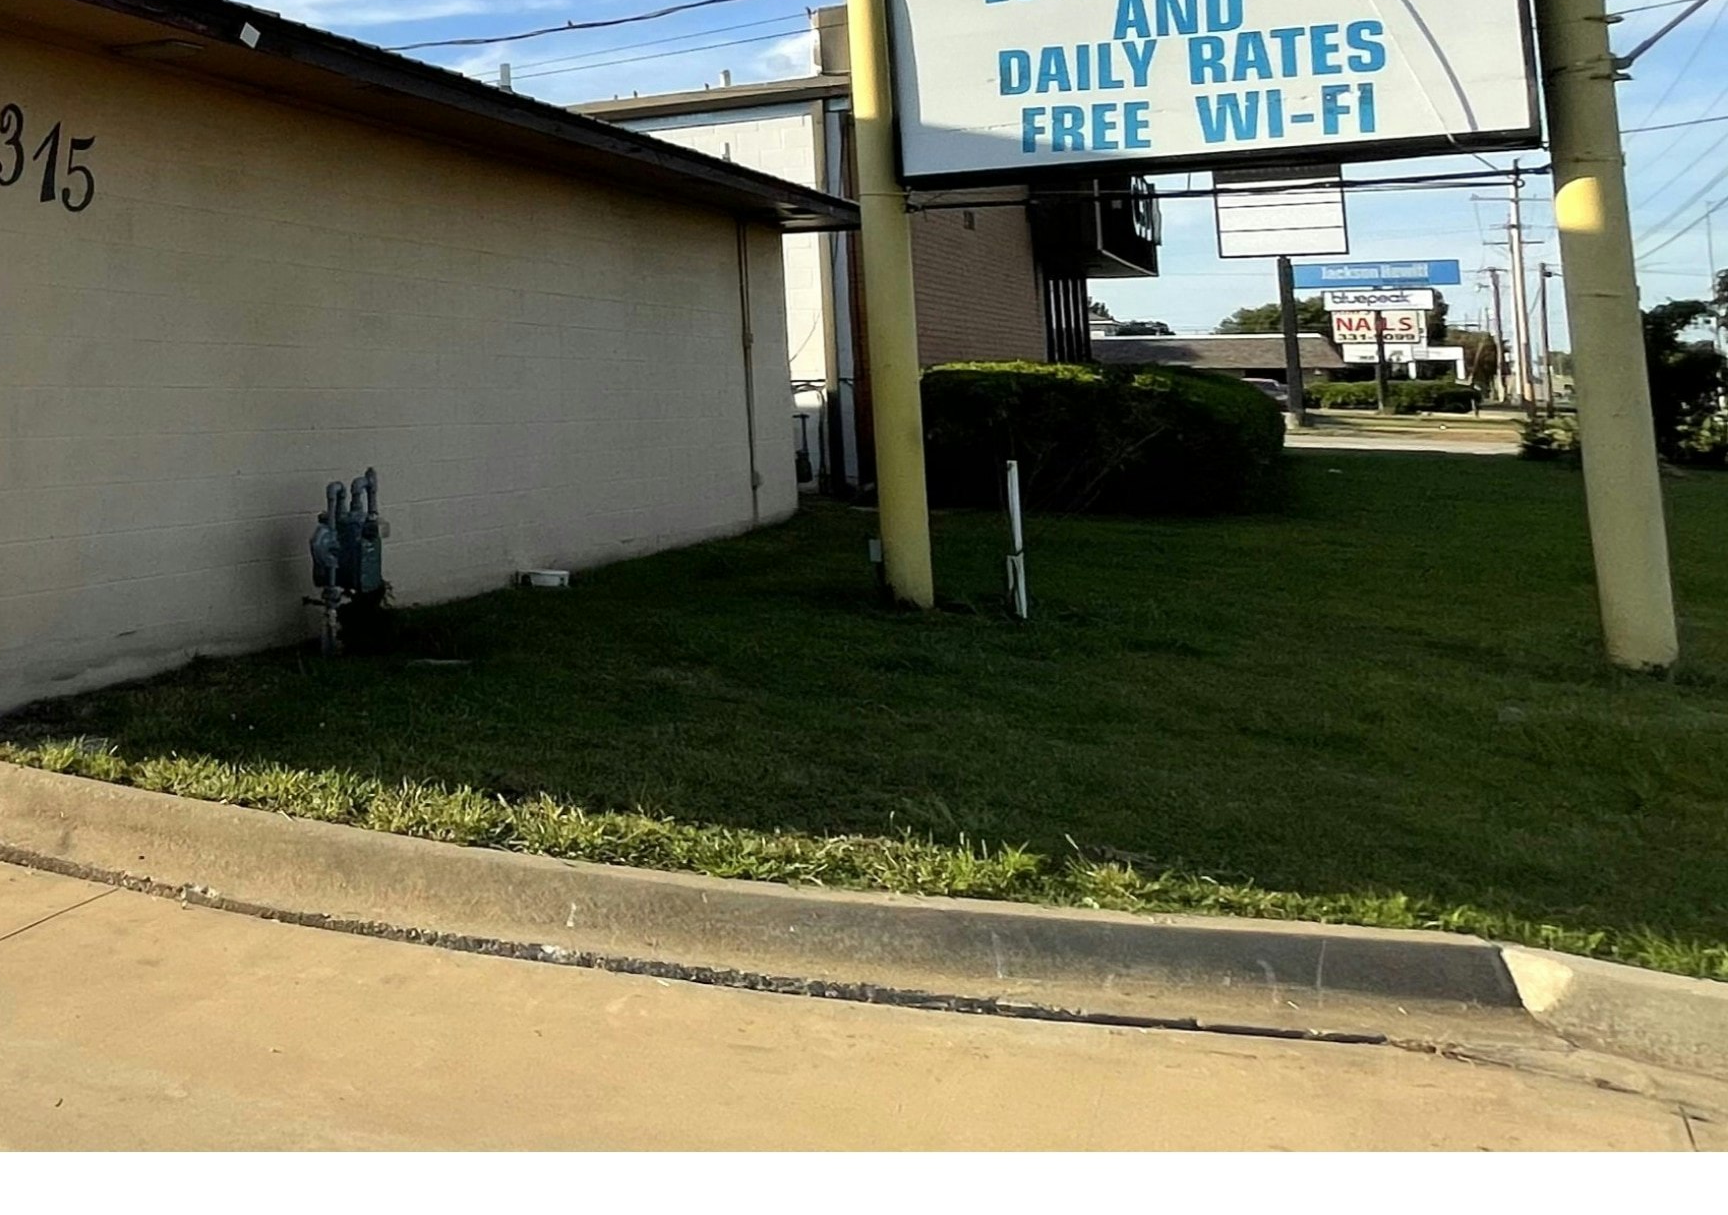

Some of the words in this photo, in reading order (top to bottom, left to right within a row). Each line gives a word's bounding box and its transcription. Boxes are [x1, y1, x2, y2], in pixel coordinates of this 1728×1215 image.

[999, 41, 1155, 96] DAILY
[1189, 21, 1386, 84] RATES
[1022, 102, 1152, 153] FREE
[1197, 83, 1376, 144] WI-FI
[1336, 317, 1413, 331] NALS
[1338, 333, 1415, 341] 331-099
